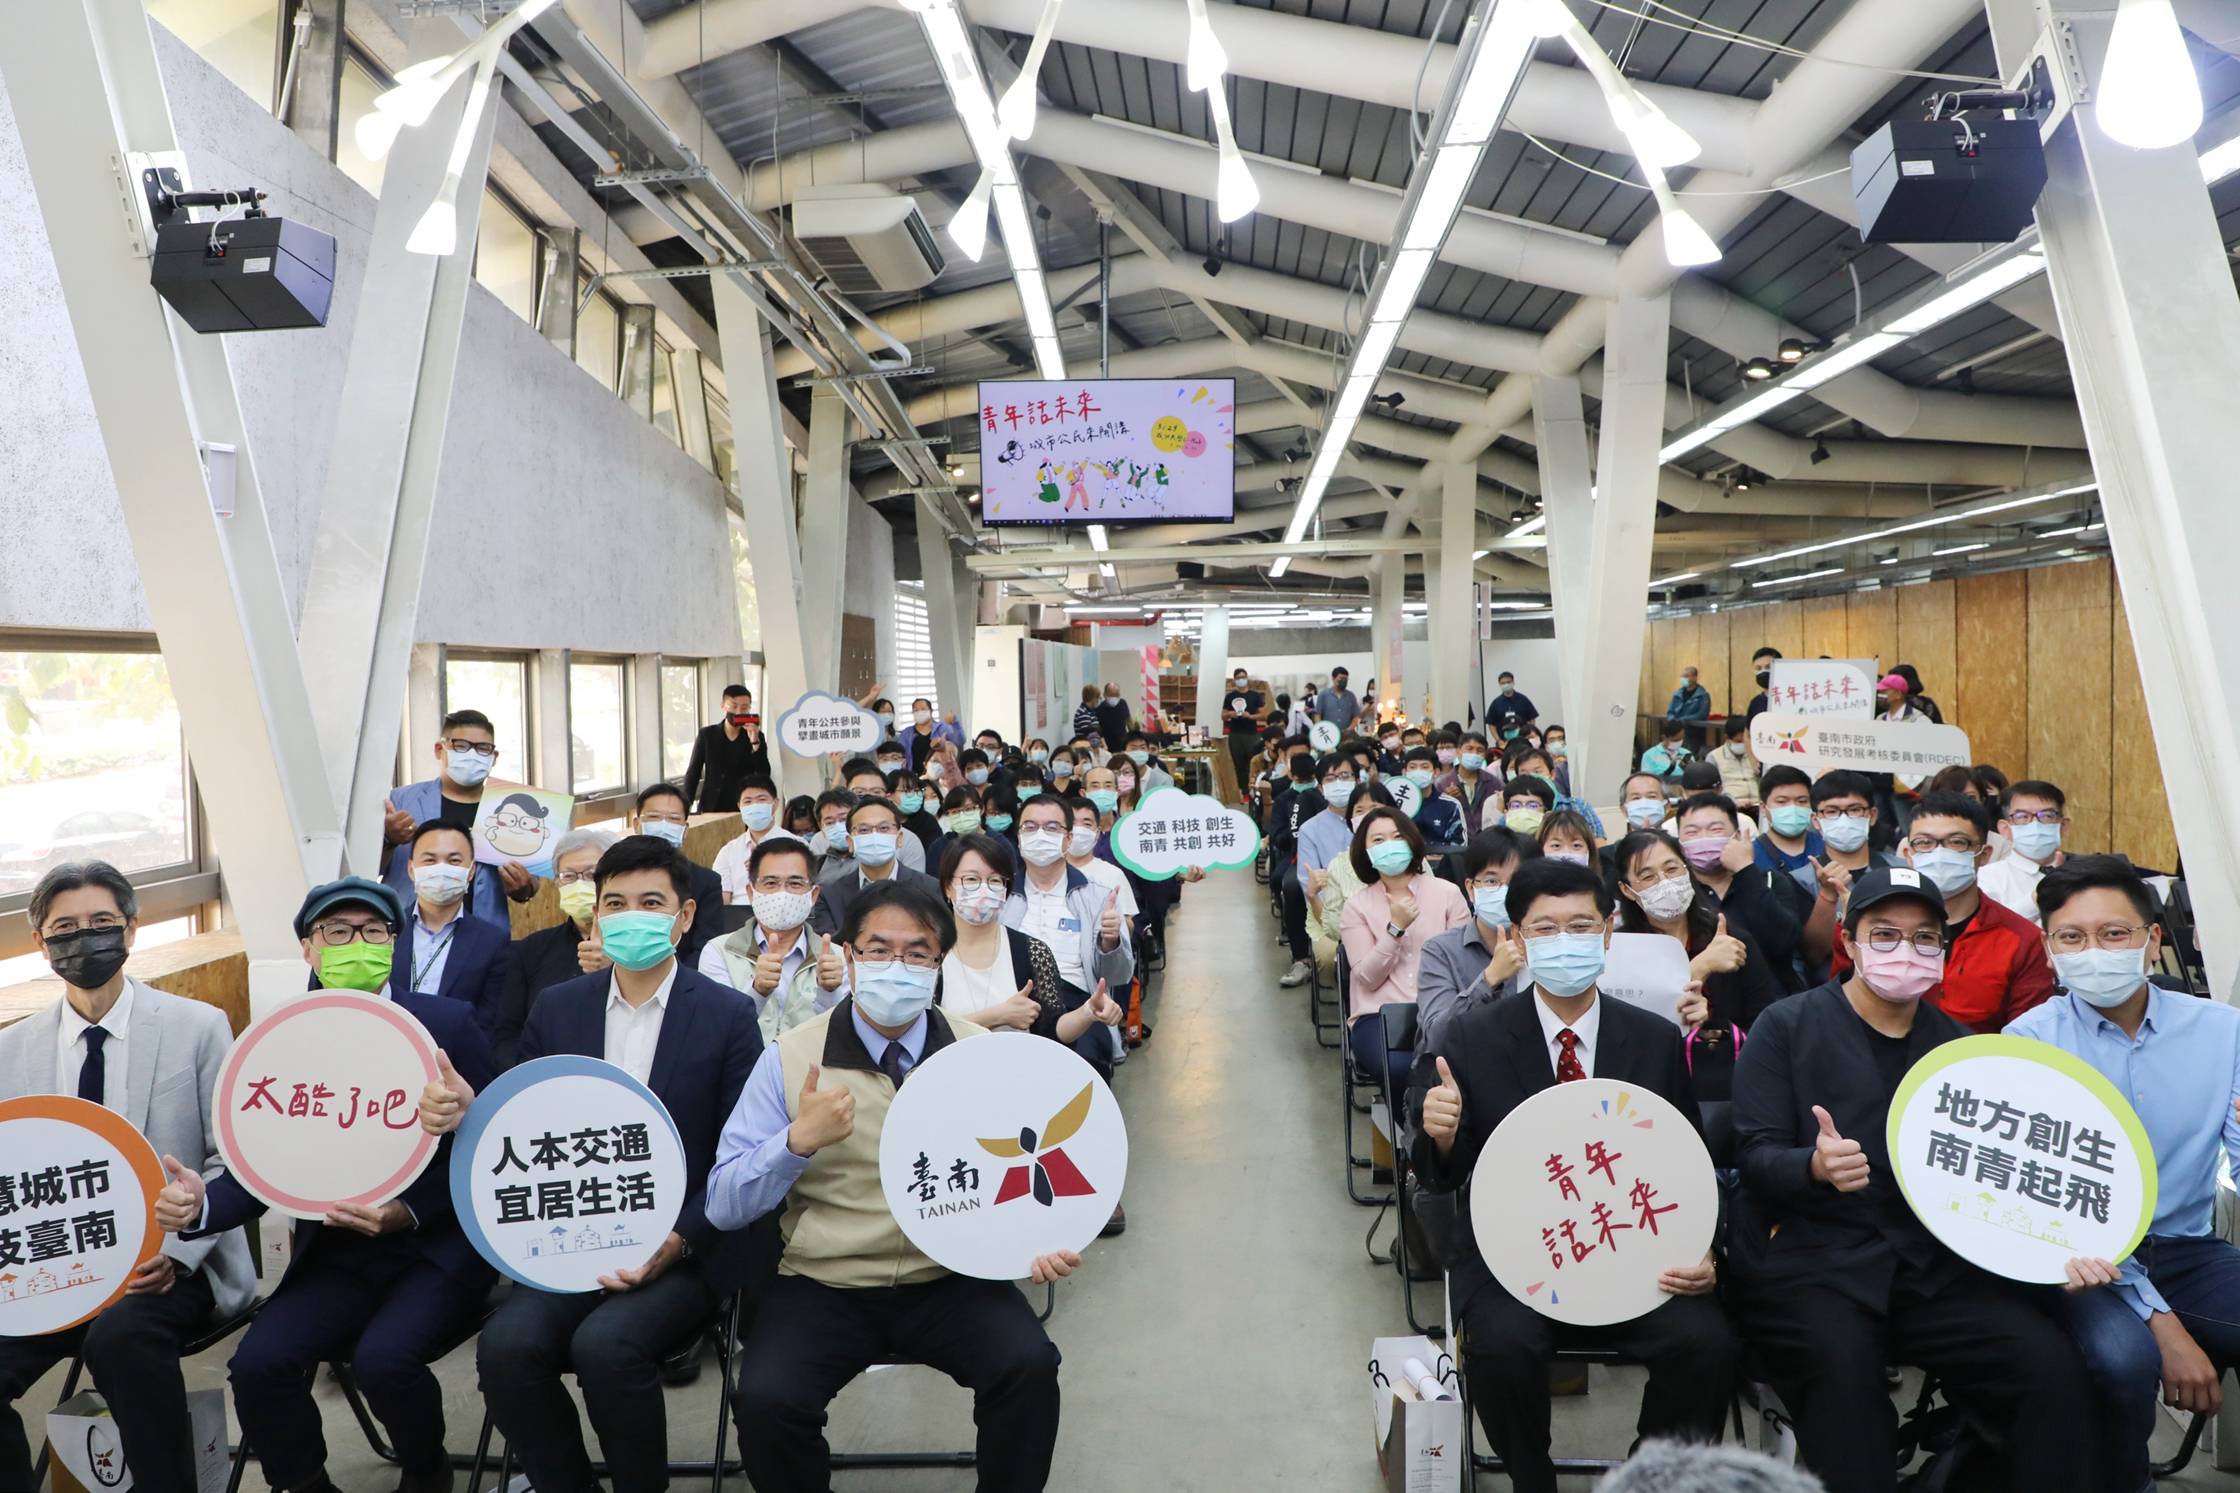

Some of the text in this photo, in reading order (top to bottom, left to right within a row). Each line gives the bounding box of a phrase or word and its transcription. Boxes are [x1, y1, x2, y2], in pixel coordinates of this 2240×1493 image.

[982, 389, 1101, 433] 青年話未來
[1771, 674, 1858, 706] 青年話未來
[798, 715, 861, 729] 青年公共參與
[1138, 816, 1234, 836] 交通 科技 創生
[1139, 833, 1236, 854] 南青 共創 共好
[241, 1076, 419, 1129] 太酷了吧
[1934, 1082, 2116, 1174] 地方創生
[492, 1122, 652, 1176] 人本交通
[1545, 1141, 1622, 1201] 青年
[495, 1171, 655, 1224] 宜居生活
[907, 1151, 979, 1202] 臺南
[1926, 1130, 2112, 1224] 南青起飛
[915, 1197, 981, 1220] TAINAN
[1542, 1178, 1678, 1269] 話未來
